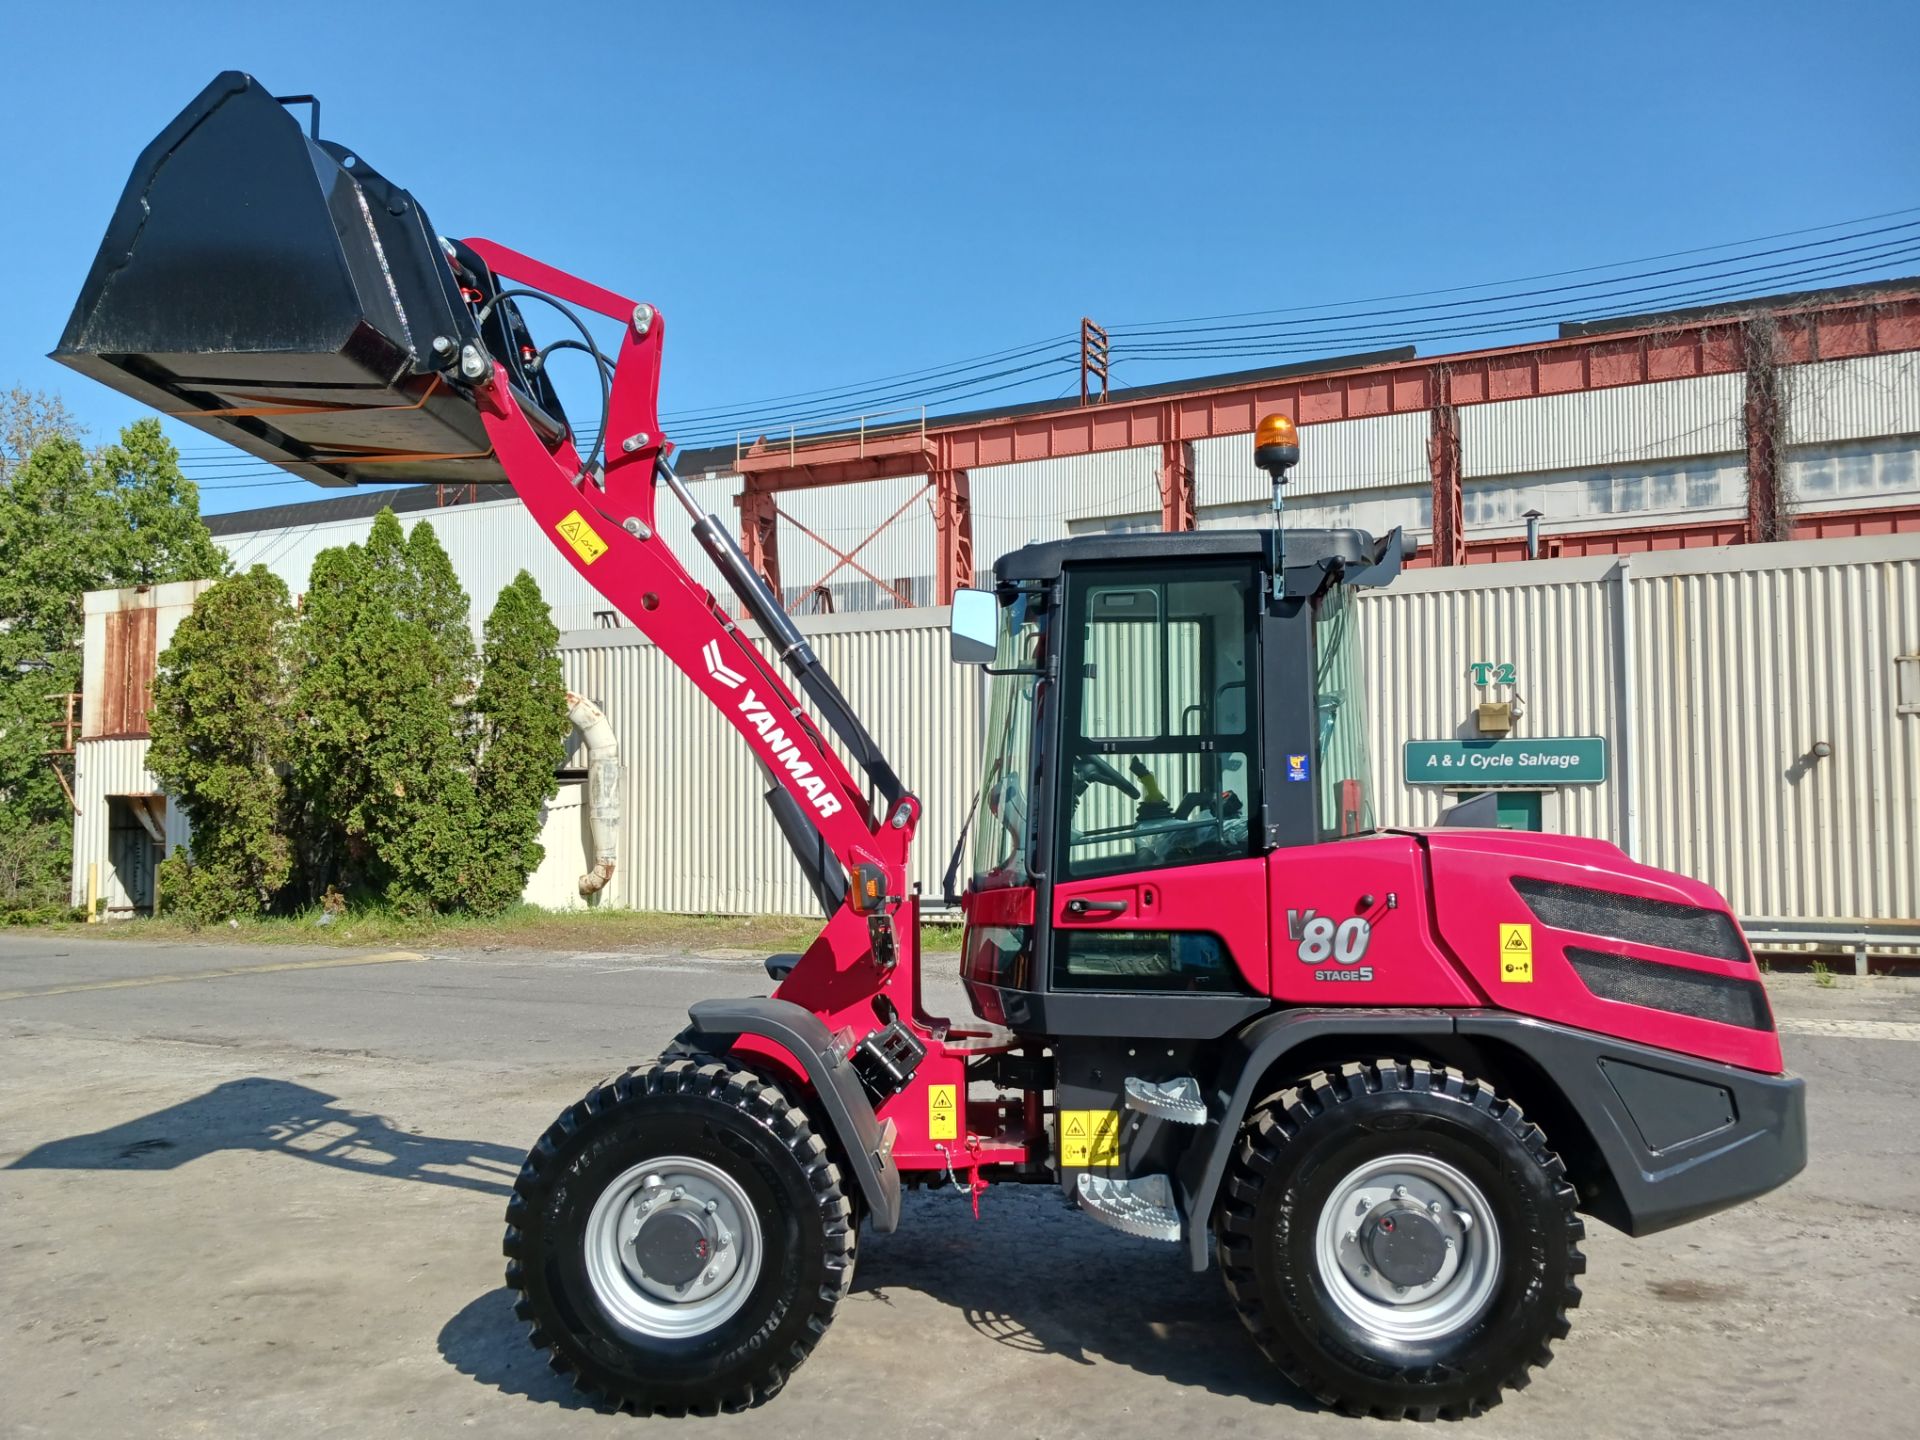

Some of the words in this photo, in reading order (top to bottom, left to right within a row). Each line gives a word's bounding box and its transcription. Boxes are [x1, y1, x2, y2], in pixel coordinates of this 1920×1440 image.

[737, 688, 843, 818] YANMAR
[1426, 754, 1438, 767] A
[1441, 754, 1453, 767] &
[1456, 754, 1466, 767] J
[1470, 753, 1514, 769] Cycle
[1517, 752, 1580, 768] Salvage
